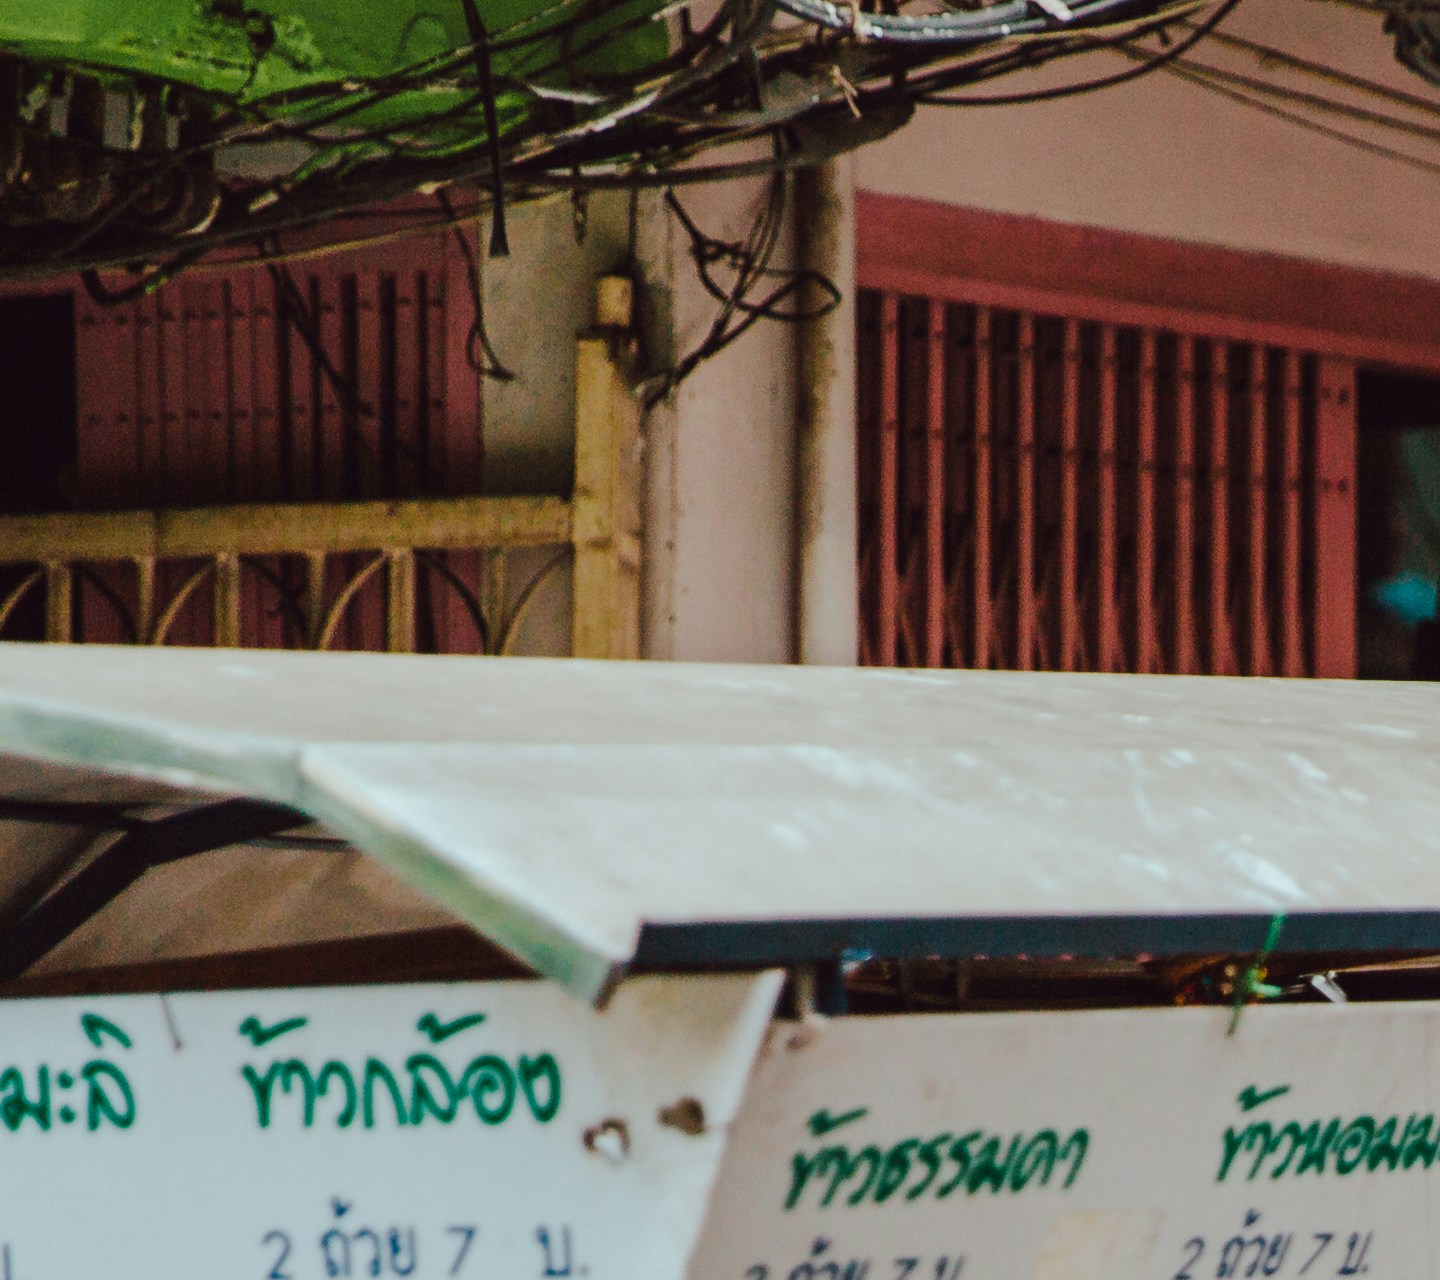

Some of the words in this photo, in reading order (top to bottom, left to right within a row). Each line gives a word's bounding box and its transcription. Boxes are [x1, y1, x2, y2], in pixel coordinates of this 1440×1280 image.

[238, 1012, 562, 1130] ข้าวกล้อง
[784, 1108, 1090, 1210] ข้าวธรรมดา
[320, 1199, 416, 1278] ถ้วย
[449, 1226, 477, 1274] 7
[537, 1228, 590, 1279] บ.
[1216, 1209, 1291, 1279] ถ้วย
[1300, 1232, 1335, 1274] 7
[1337, 1230, 1373, 1276] บ.
